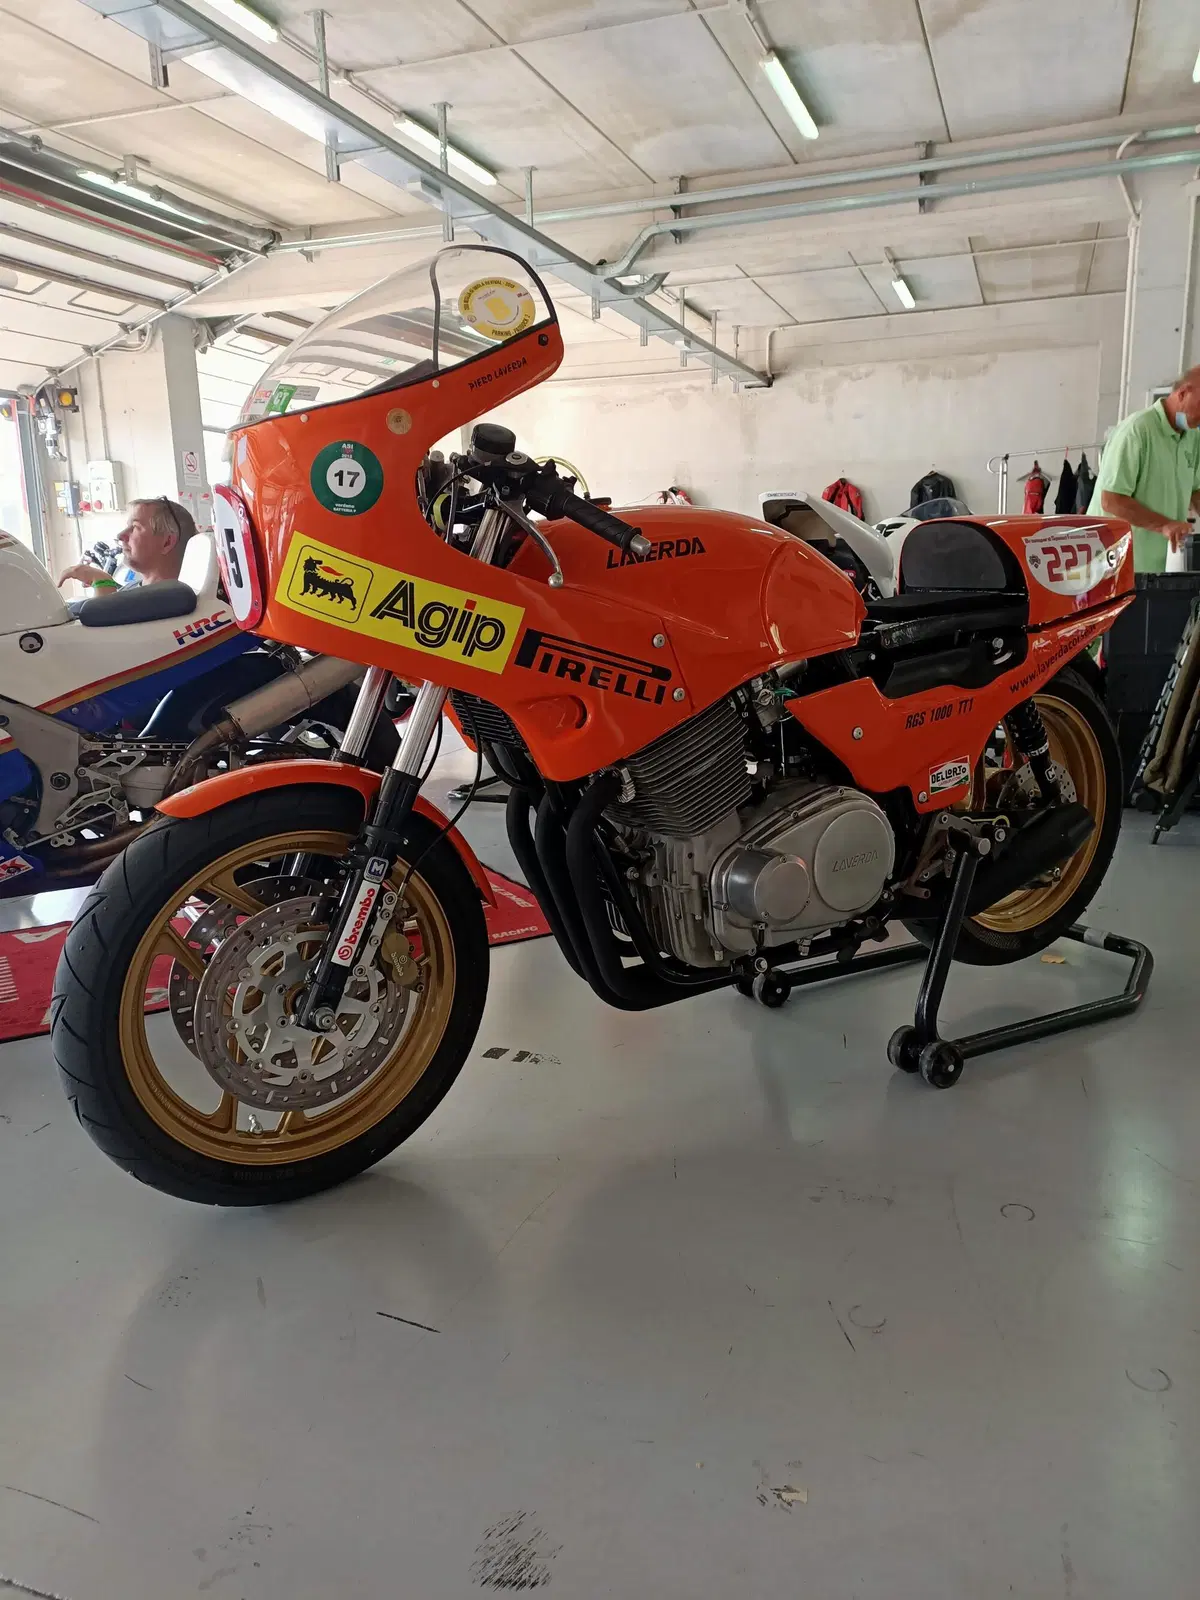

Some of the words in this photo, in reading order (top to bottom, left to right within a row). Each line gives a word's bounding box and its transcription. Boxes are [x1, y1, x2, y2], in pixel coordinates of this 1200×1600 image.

[468, 374, 493, 392] PIERO
[494, 356, 528, 379] LAVERDA
[334, 469, 360, 488] 17
[1041, 543, 1092, 583] 227
[172, 610, 233, 645] HRC
[369, 578, 506, 658] Agip
[514, 628, 672, 705] PIRELLI
[904, 711, 927, 730] RGS
[930, 703, 953, 723] 1000
[958, 697, 974, 715] TT1
[831, 850, 879, 873] LAVERDA
[344, 887, 376, 945] brembo
[390, 951, 405, 977] brembo
